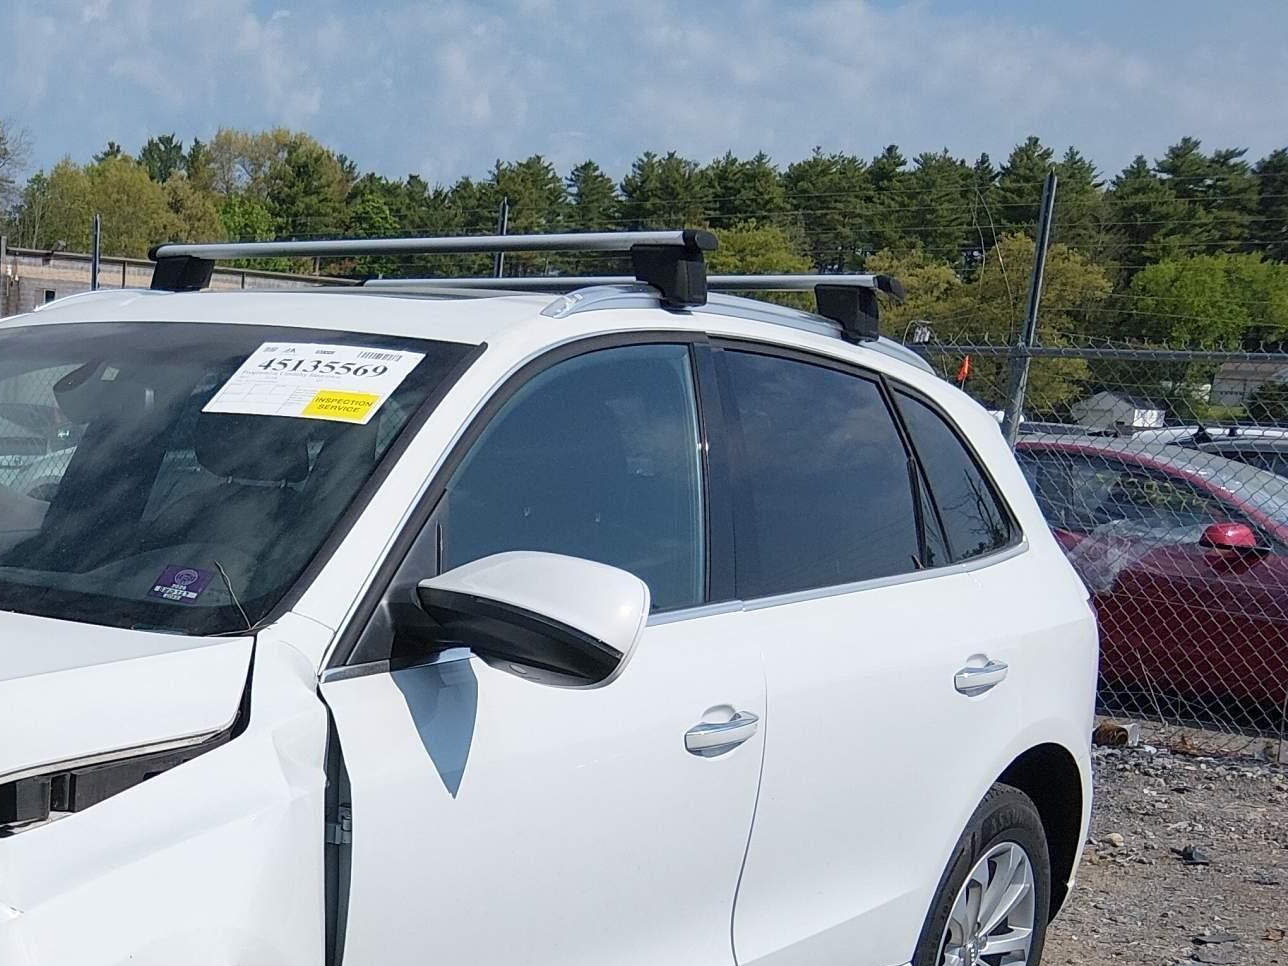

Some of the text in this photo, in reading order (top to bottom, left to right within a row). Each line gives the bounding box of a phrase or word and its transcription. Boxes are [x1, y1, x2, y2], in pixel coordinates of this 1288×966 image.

[258, 357, 388, 378] 45135569
[315, 396, 373, 407] INSPECTION
[317, 404, 361, 413] SERVICE
